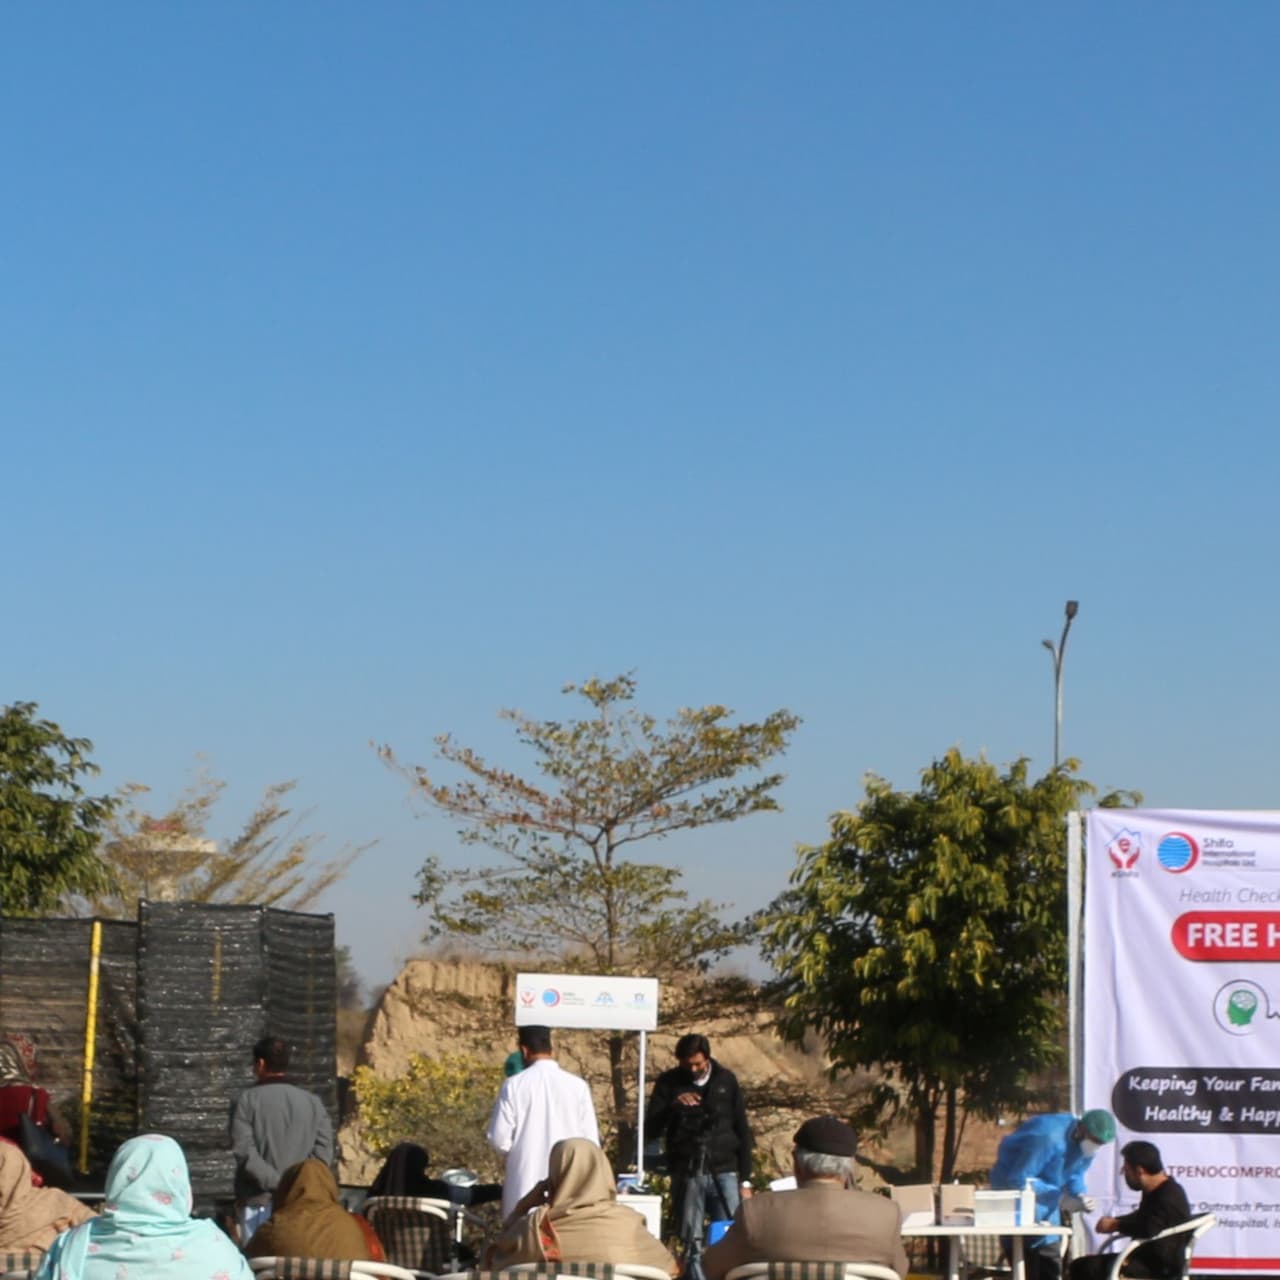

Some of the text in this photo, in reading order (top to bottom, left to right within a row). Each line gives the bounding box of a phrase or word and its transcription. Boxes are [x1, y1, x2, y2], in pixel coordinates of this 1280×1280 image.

[1202, 838, 1234, 849] Shifa
[1179, 888, 1232, 903] Health
[1187, 922, 1259, 948] FREE
[1129, 1075, 1198, 1096] Keeping
[1203, 1076, 1246, 1091] Your
[1145, 1104, 1213, 1126] Healthy
[1219, 1106, 1235, 1122] &
[1198, 1201, 1252, 1213] Outreach
